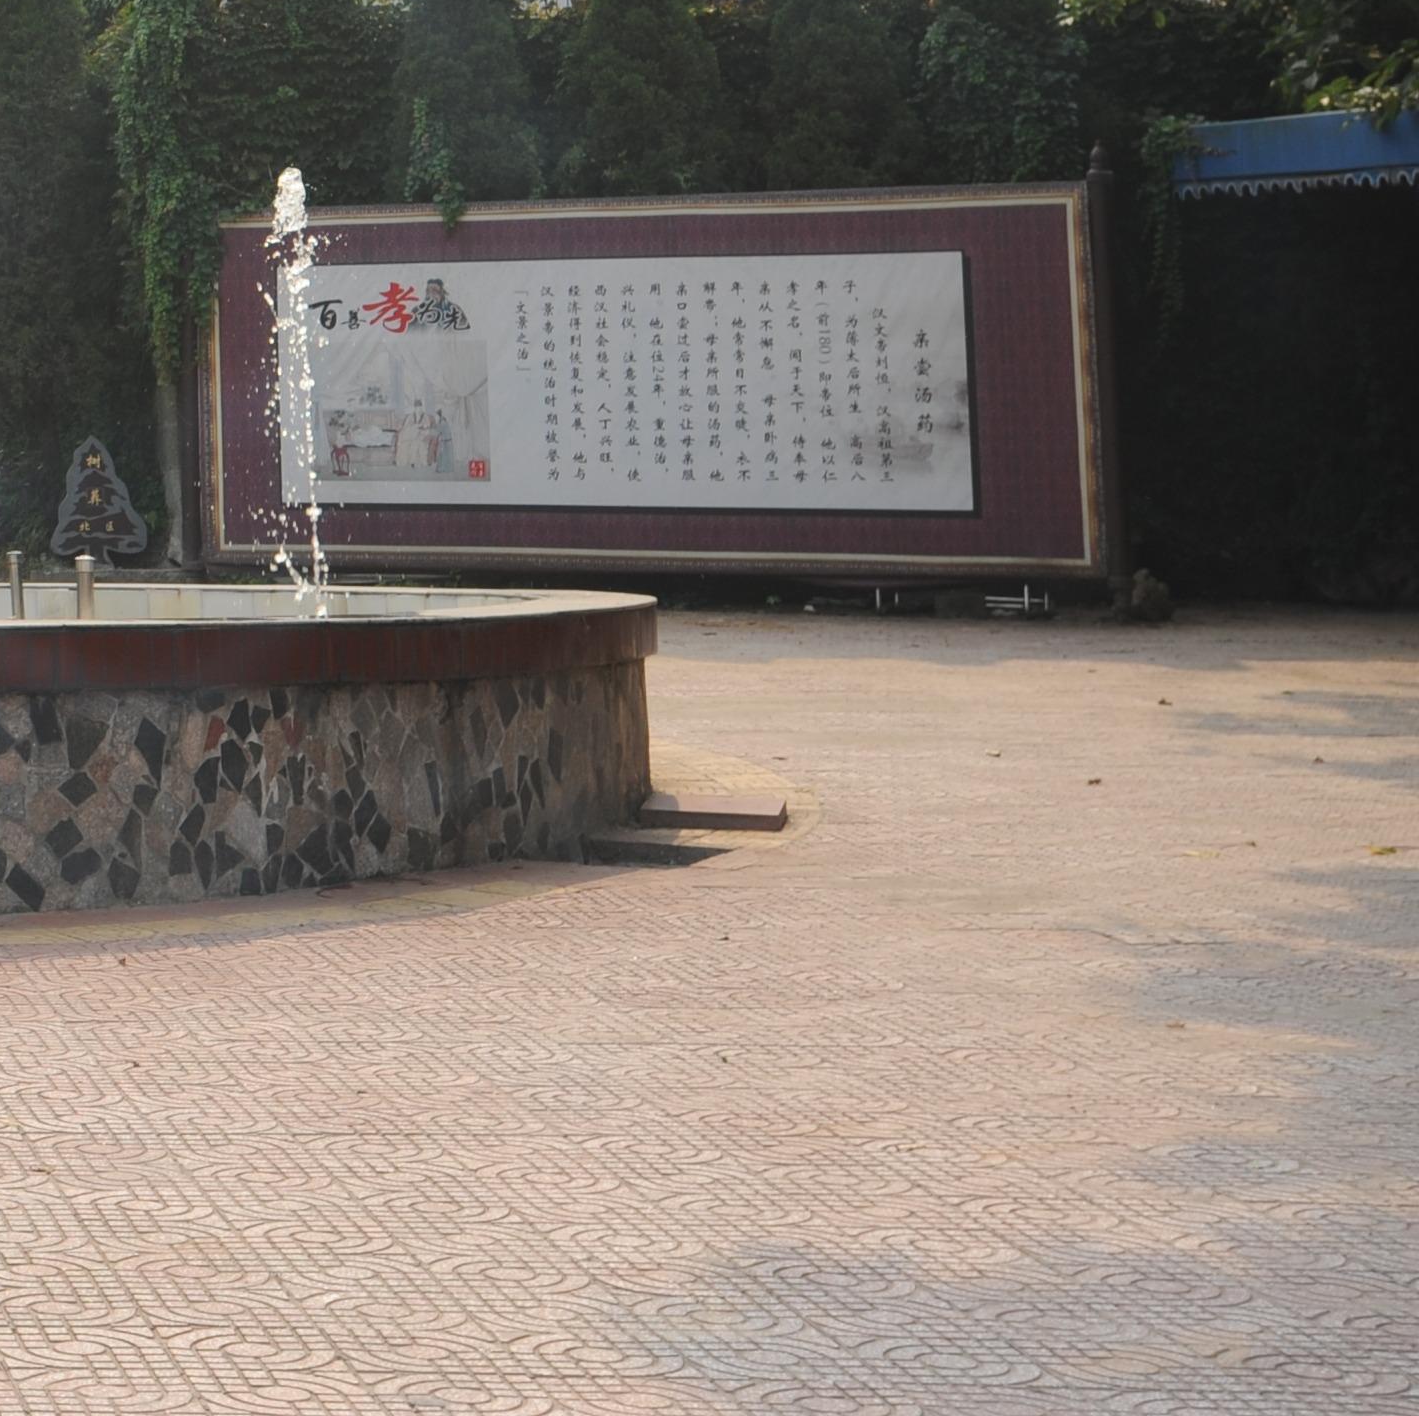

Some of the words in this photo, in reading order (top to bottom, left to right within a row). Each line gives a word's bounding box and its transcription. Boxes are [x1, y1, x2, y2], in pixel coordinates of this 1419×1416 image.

[308, 282, 471, 334] 百善孝为先
[912, 328, 934, 434] 亲尝汤药
